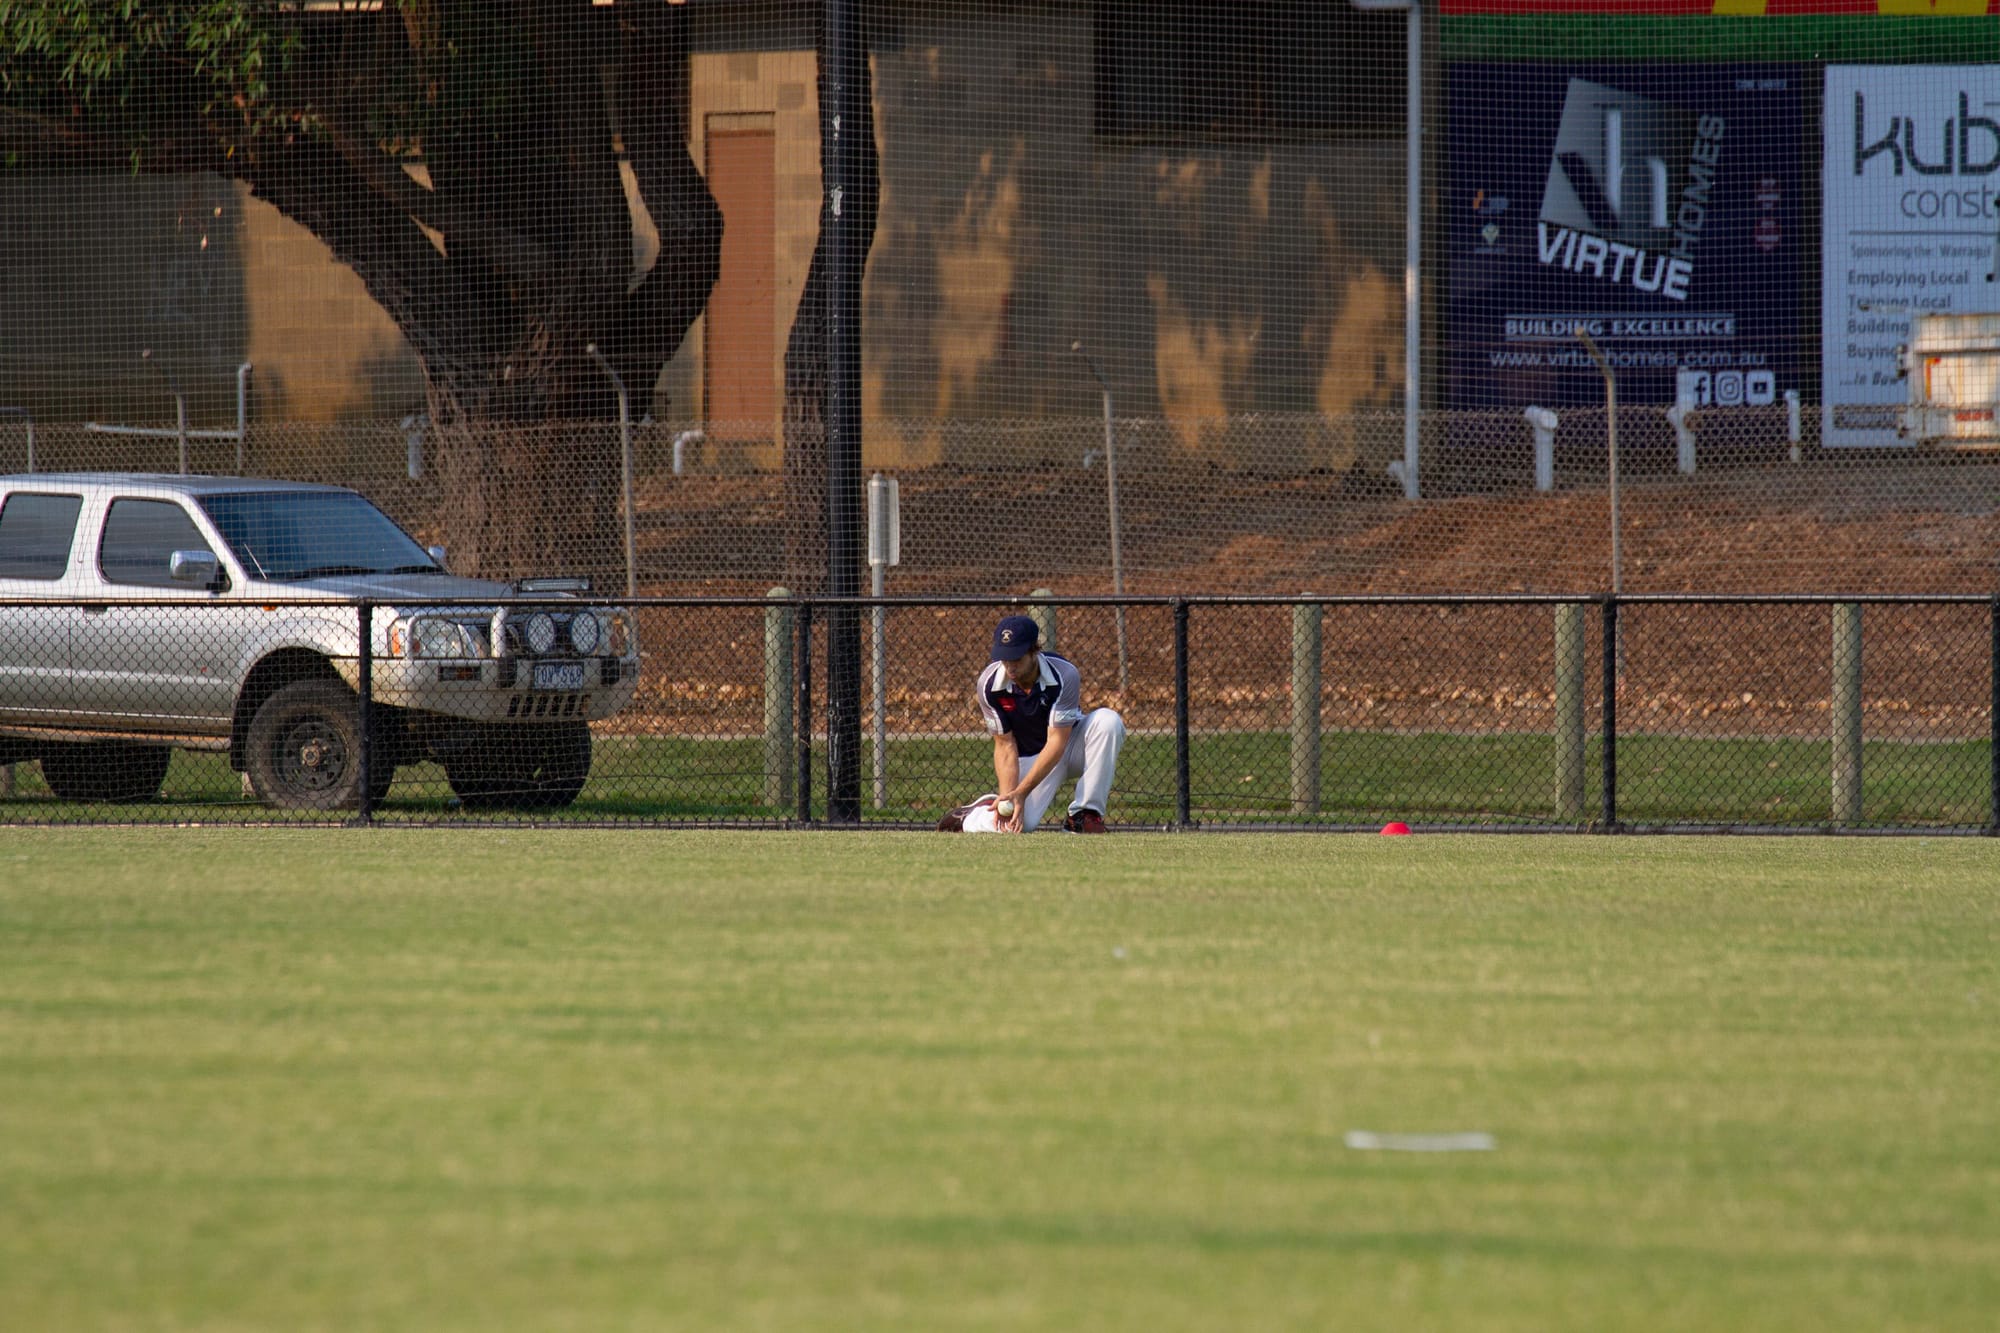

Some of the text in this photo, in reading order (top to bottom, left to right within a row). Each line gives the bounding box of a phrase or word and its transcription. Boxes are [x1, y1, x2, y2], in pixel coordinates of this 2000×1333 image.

[1670, 114, 1725, 259] HOMES
[1537, 222, 1694, 301] VIRTUE
[1848, 270, 1968, 288] Employing Local
[1914, 294, 1951, 308] Local
[1505, 319, 1735, 335] BUILDING EXCELLENCE
[1848, 319, 1909, 337] Building
[1847, 343, 1898, 360] Buying
